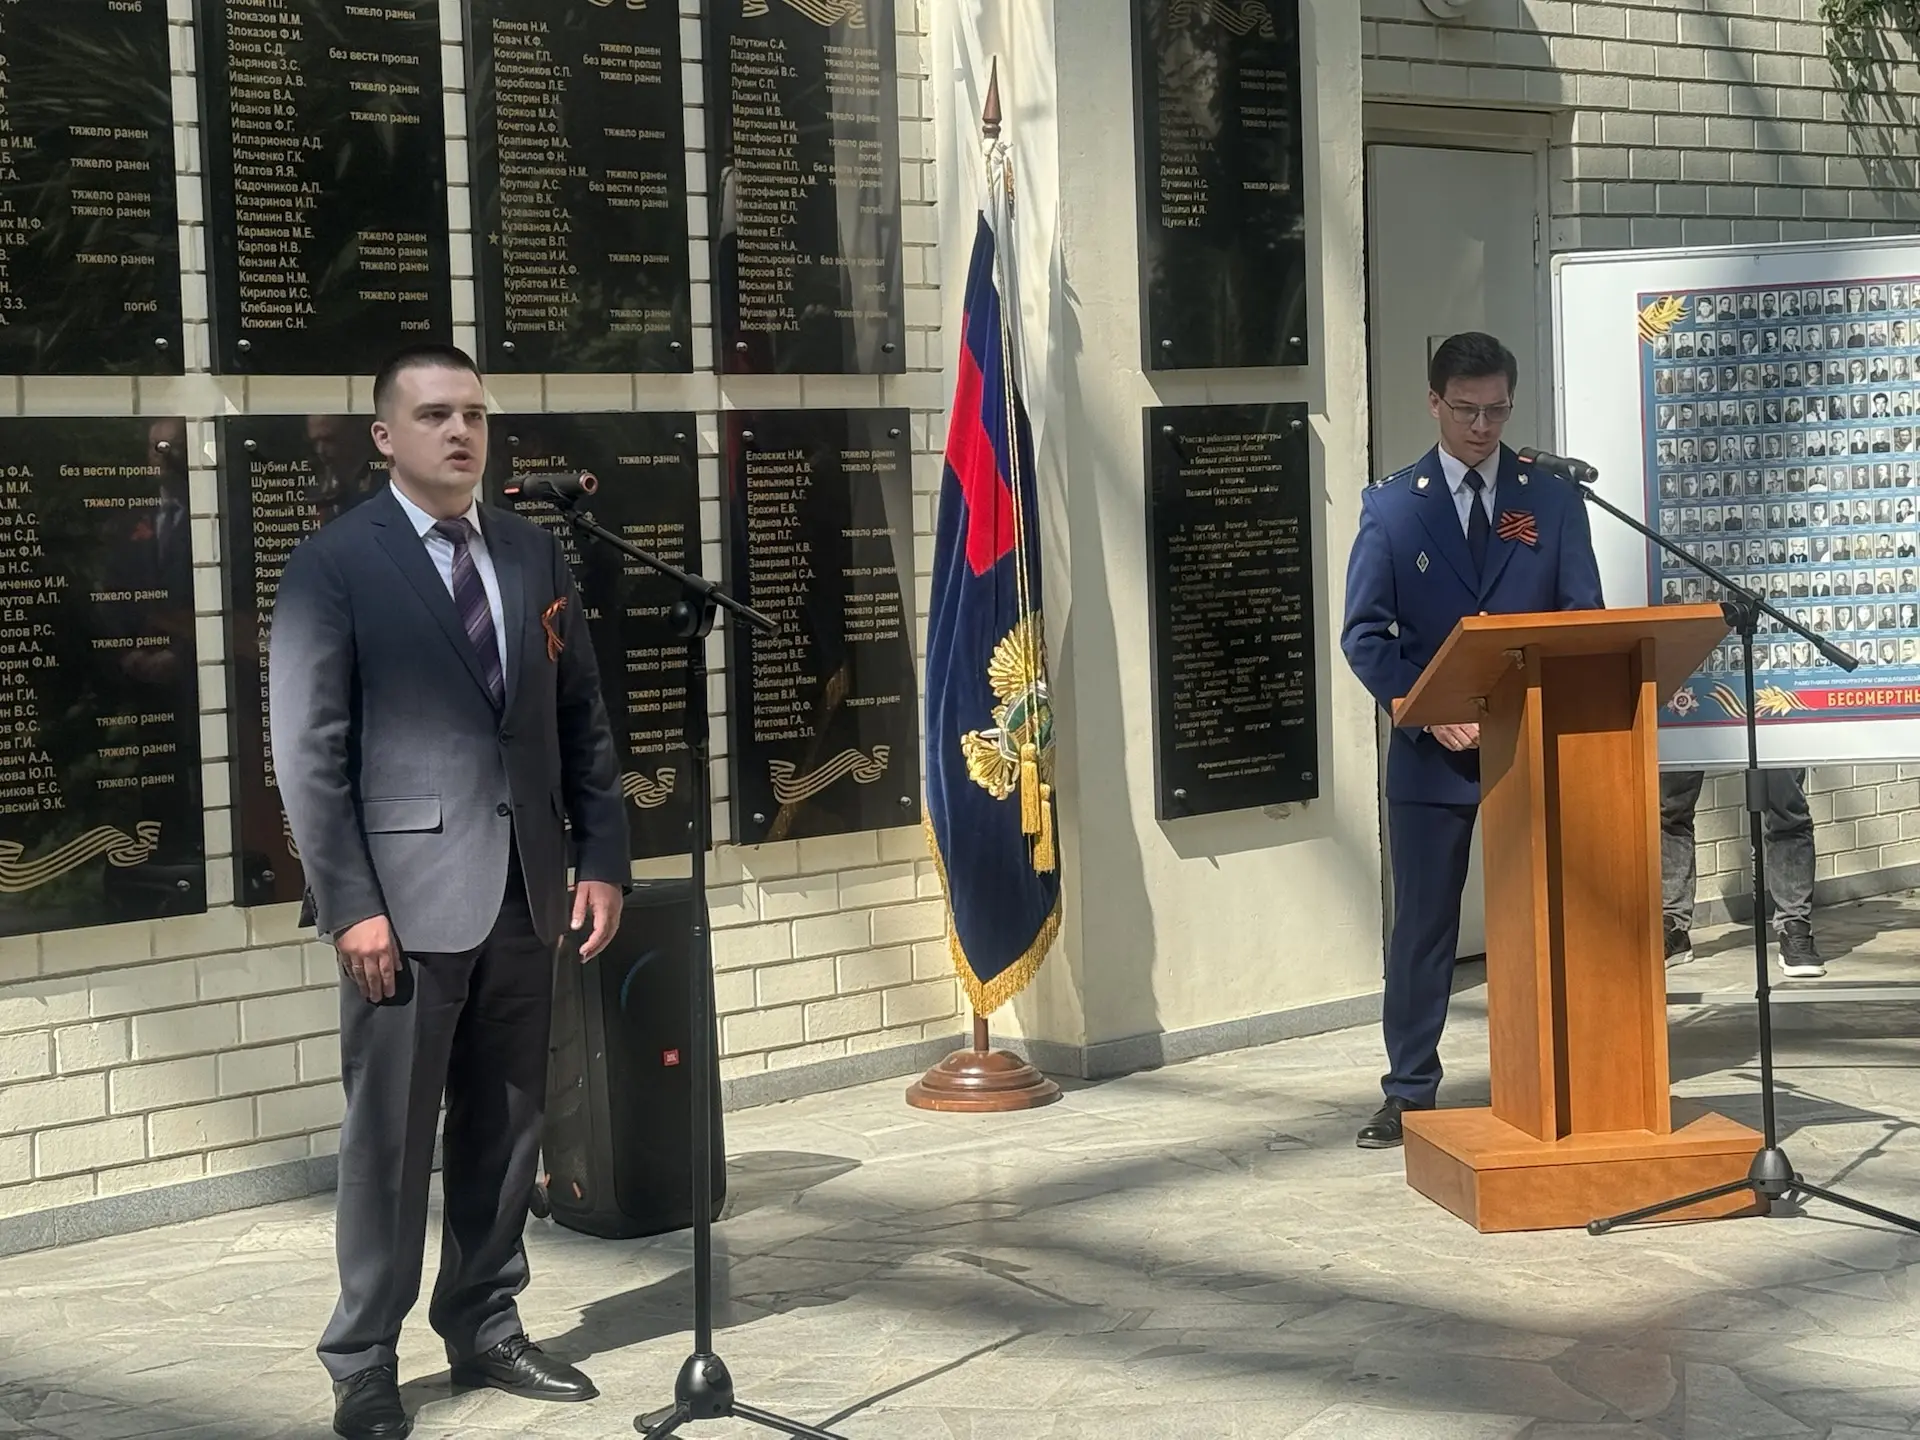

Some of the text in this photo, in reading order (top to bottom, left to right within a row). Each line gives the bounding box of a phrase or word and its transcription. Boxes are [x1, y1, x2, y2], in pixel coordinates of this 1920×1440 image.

[108, 1, 142, 12] погиб
[345, 6, 416, 20] тяжело ранен
[226, 8, 303, 25] Злоказов М.М.
[227, 23, 303, 40] Злоказов Ф.И.
[227, 39, 286, 57] Зонов С.Д.
[599, 43, 661, 56] тяжело ранен
[228, 54, 278, 70] Зырянов
[329, 47, 419, 65] без вести пропал
[583, 54, 662, 70] без вести пропал
[229, 70, 306, 87] Иванисов А.В.
[600, 71, 661, 84] тяжело ранен
[230, 86, 295, 101] Иванов В.А.
[349, 81, 420, 96] тяжело ранен
[231, 101, 298, 117] Иванов М.Ф.
[231, 117, 295, 131] Иванов Ф.Г.
[350, 112, 420, 125] тяжело ранен
[69, 126, 148, 140] тяжело ранен
[604, 128, 665, 140] тяжело ранен
[11, 136, 36, 148] И.М.
[232, 132, 323, 150] Илларионов А.Д.
[233, 147, 304, 163] Ильченко Г.К.
[70, 158, 150, 172] тяжело ранен
[234, 163, 297, 177] Ипатов Я.Я.
[235, 178, 323, 194] Кадочников А.П.
[71, 190, 151, 203] тяжело ранен
[235, 194, 293, 209] Казаринов
[71, 206, 150, 219] тяжело ранен
[236, 209, 305, 223] Калинин В.К.
[17, 217, 45, 230] М.Ф.
[237, 225, 290, 239] Карманов
[357, 231, 427, 244] тяжело ранен
[238, 240, 277, 254] Карпов
[358, 246, 428, 258] тяжело ранен
[76, 254, 155, 266] тяжело ранен
[238, 255, 276, 268] Кензин
[360, 261, 429, 273] тяжело ранен
[239, 270, 284, 283] Киселев
[358, 290, 428, 303] тяжело ранен
[124, 300, 157, 311] погиб
[241, 301, 316, 314] Клебанов И.А.
[241, 316, 307, 328] Клюкин С.Н.
[401, 319, 430, 330] погиб
[512, 457, 549, 470] Бровин
[618, 455, 680, 465] тяжело ранен
[7, 465, 33, 477] Ф.А.
[60, 464, 161, 478] без вести пропал
[250, 460, 311, 475] Шубин А.Е.
[6, 481, 32, 493] М.И.
[251, 476, 295, 490] Шумков
[83, 497, 162, 509] тяжело ранен
[252, 490, 308, 504] Юдин П.С.
[253, 505, 320, 518] Южный В.М.
[253, 521, 300, 533] Юношев
[623, 524, 684, 534] тяжело ранен
[45, 576, 68, 588] И.И.
[36, 592, 60, 604] А.П.
[90, 590, 168, 602] тяжело ранен
[845, 592, 899, 602] тяжело ранен
[33, 624, 55, 636] Р.С.
[91, 636, 170, 648] тяжело ранен
[32, 655, 59, 667] Ф.М.
[96, 713, 174, 726] тяжело ранен
[98, 743, 176, 758] тяжело ранен
[29, 766, 56, 779] Ю.П.
[38, 781, 61, 794] Е.С.
[96, 774, 174, 789] тяжело ранен
[43, 797, 65, 809] Э.К.
